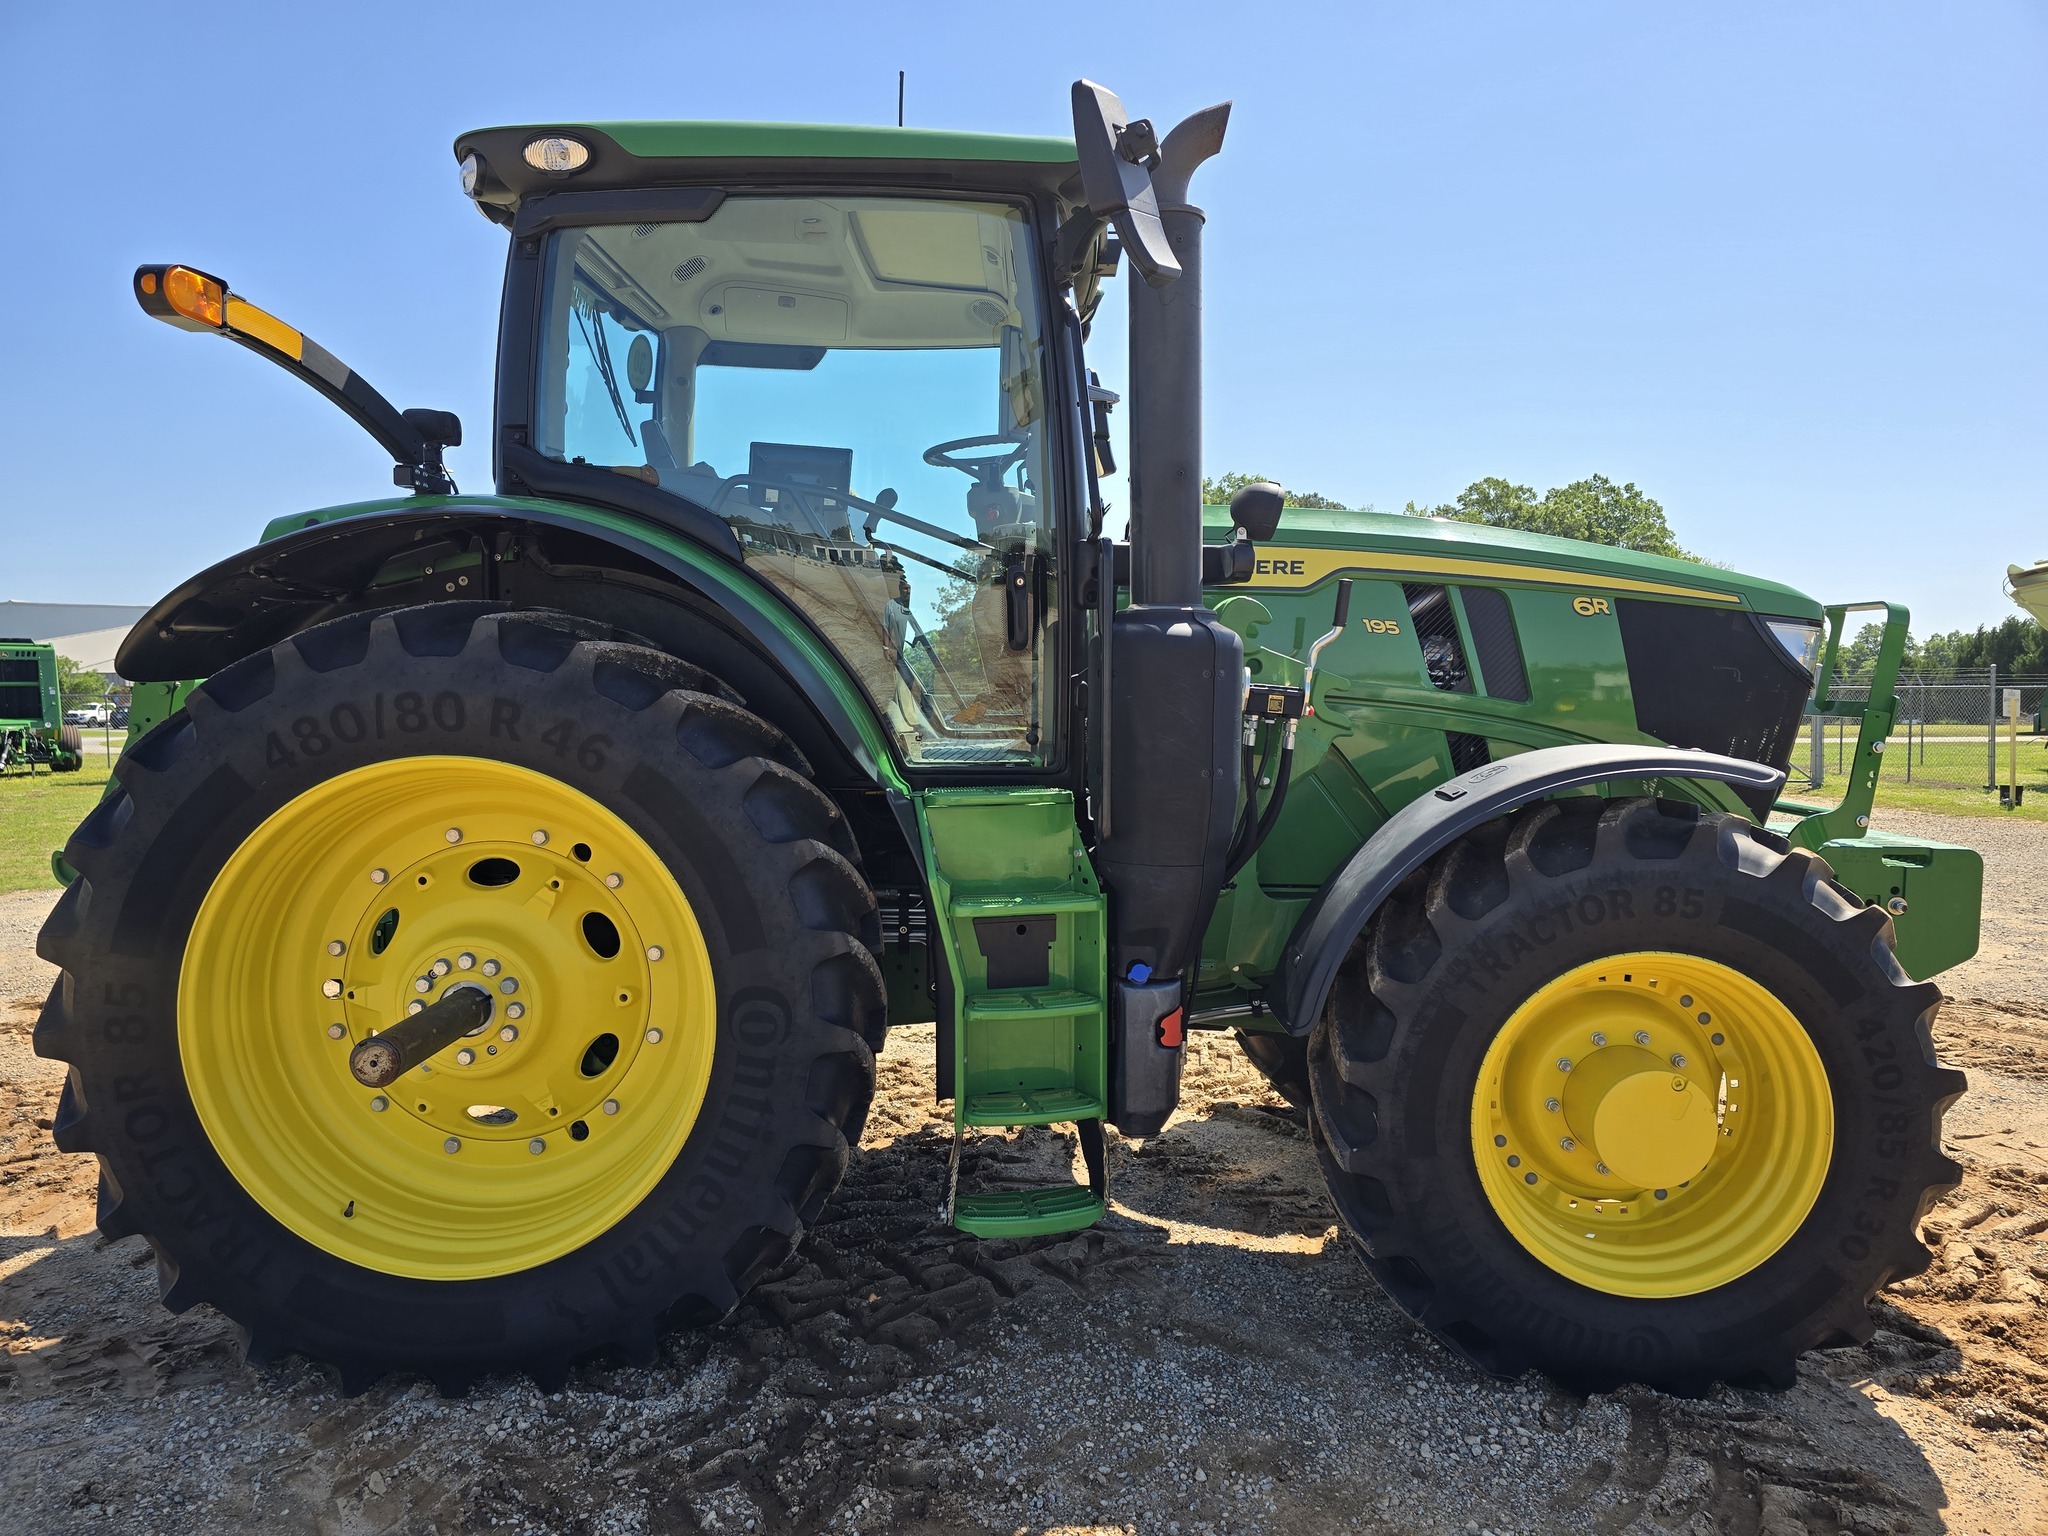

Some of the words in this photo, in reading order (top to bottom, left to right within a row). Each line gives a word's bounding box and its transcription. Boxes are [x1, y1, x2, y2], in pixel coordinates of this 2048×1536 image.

[1256, 559, 1305, 575] ERE
[1362, 618, 1401, 635] 195
[1572, 596, 1612, 617] 6R
[264, 690, 467, 771] 480/80
[489, 697, 523, 743] R
[540, 715, 615, 773] 46
[1452, 887, 1637, 994] TRACTOR
[1653, 885, 1705, 920] 85
[103, 981, 152, 1047] 85
[1855, 1018, 1912, 1160] 420/85
[113, 1065, 275, 1291] TRACTOR
[592, 985, 794, 1311] Continental
[1865, 1174, 1901, 1202] R
[1838, 1210, 1886, 1262] 30
